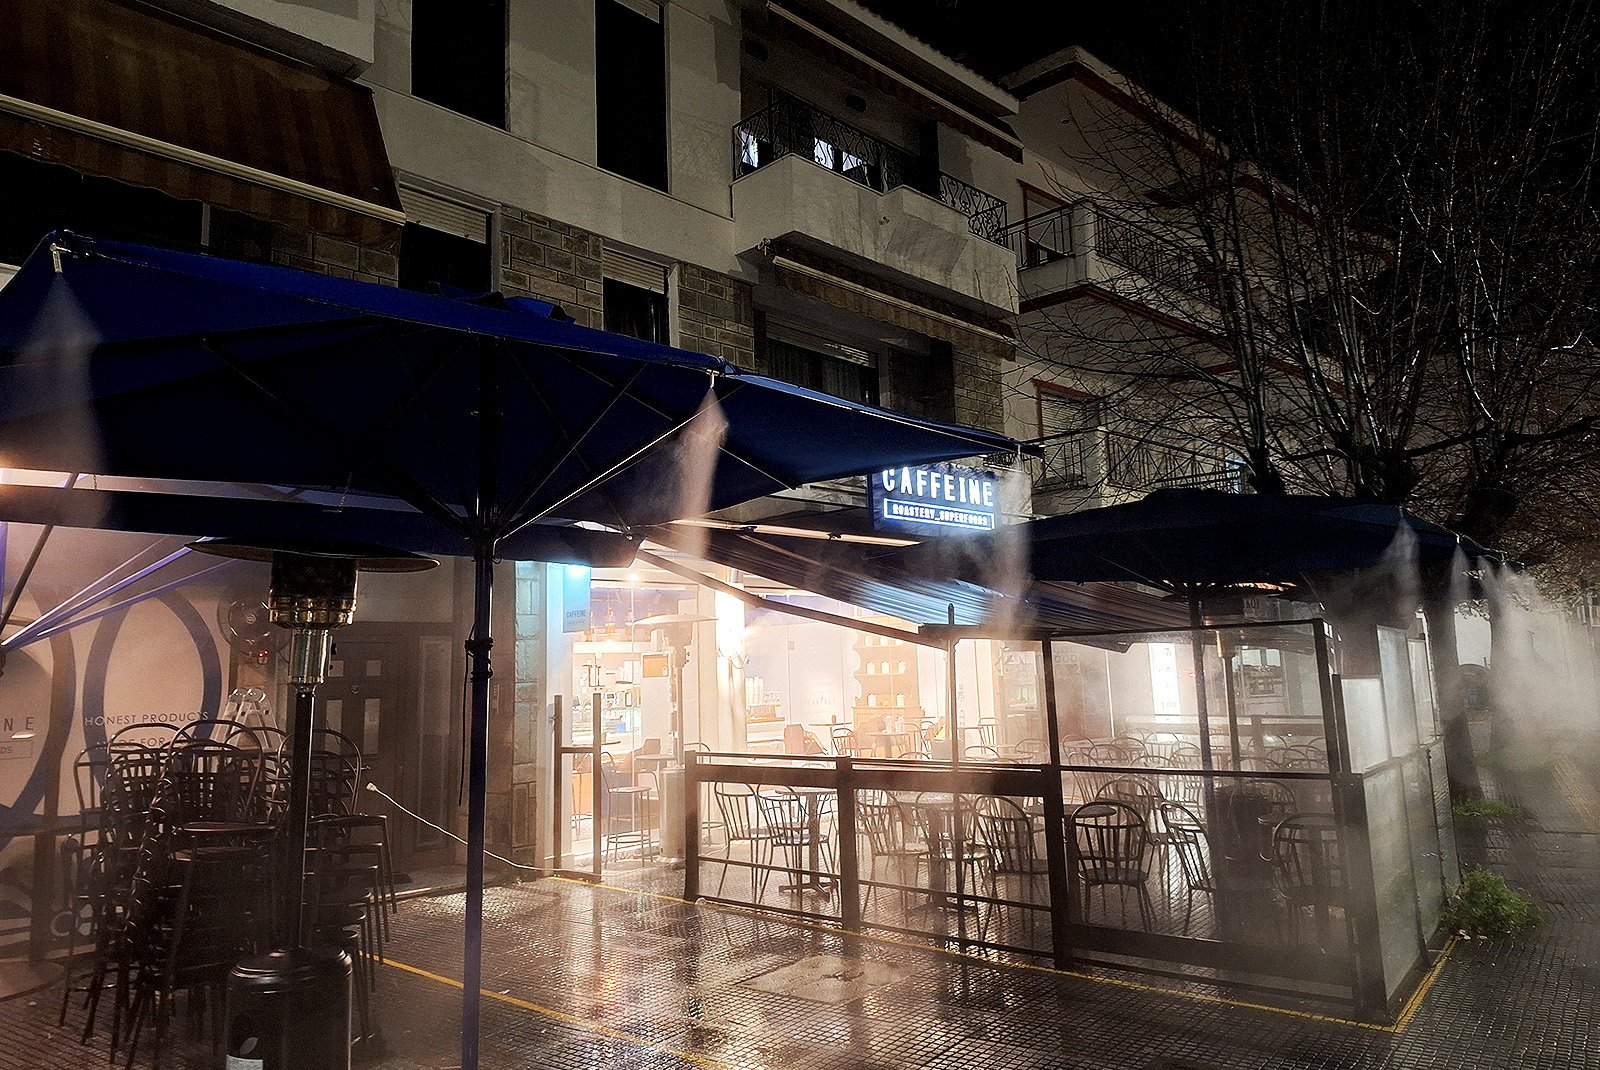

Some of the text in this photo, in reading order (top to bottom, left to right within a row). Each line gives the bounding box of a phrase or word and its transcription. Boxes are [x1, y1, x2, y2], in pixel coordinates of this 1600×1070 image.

[882, 467, 994, 507] CAFFEINE
[84, 714, 136, 726] HONEST
[140, 737, 165, 747] FOR
